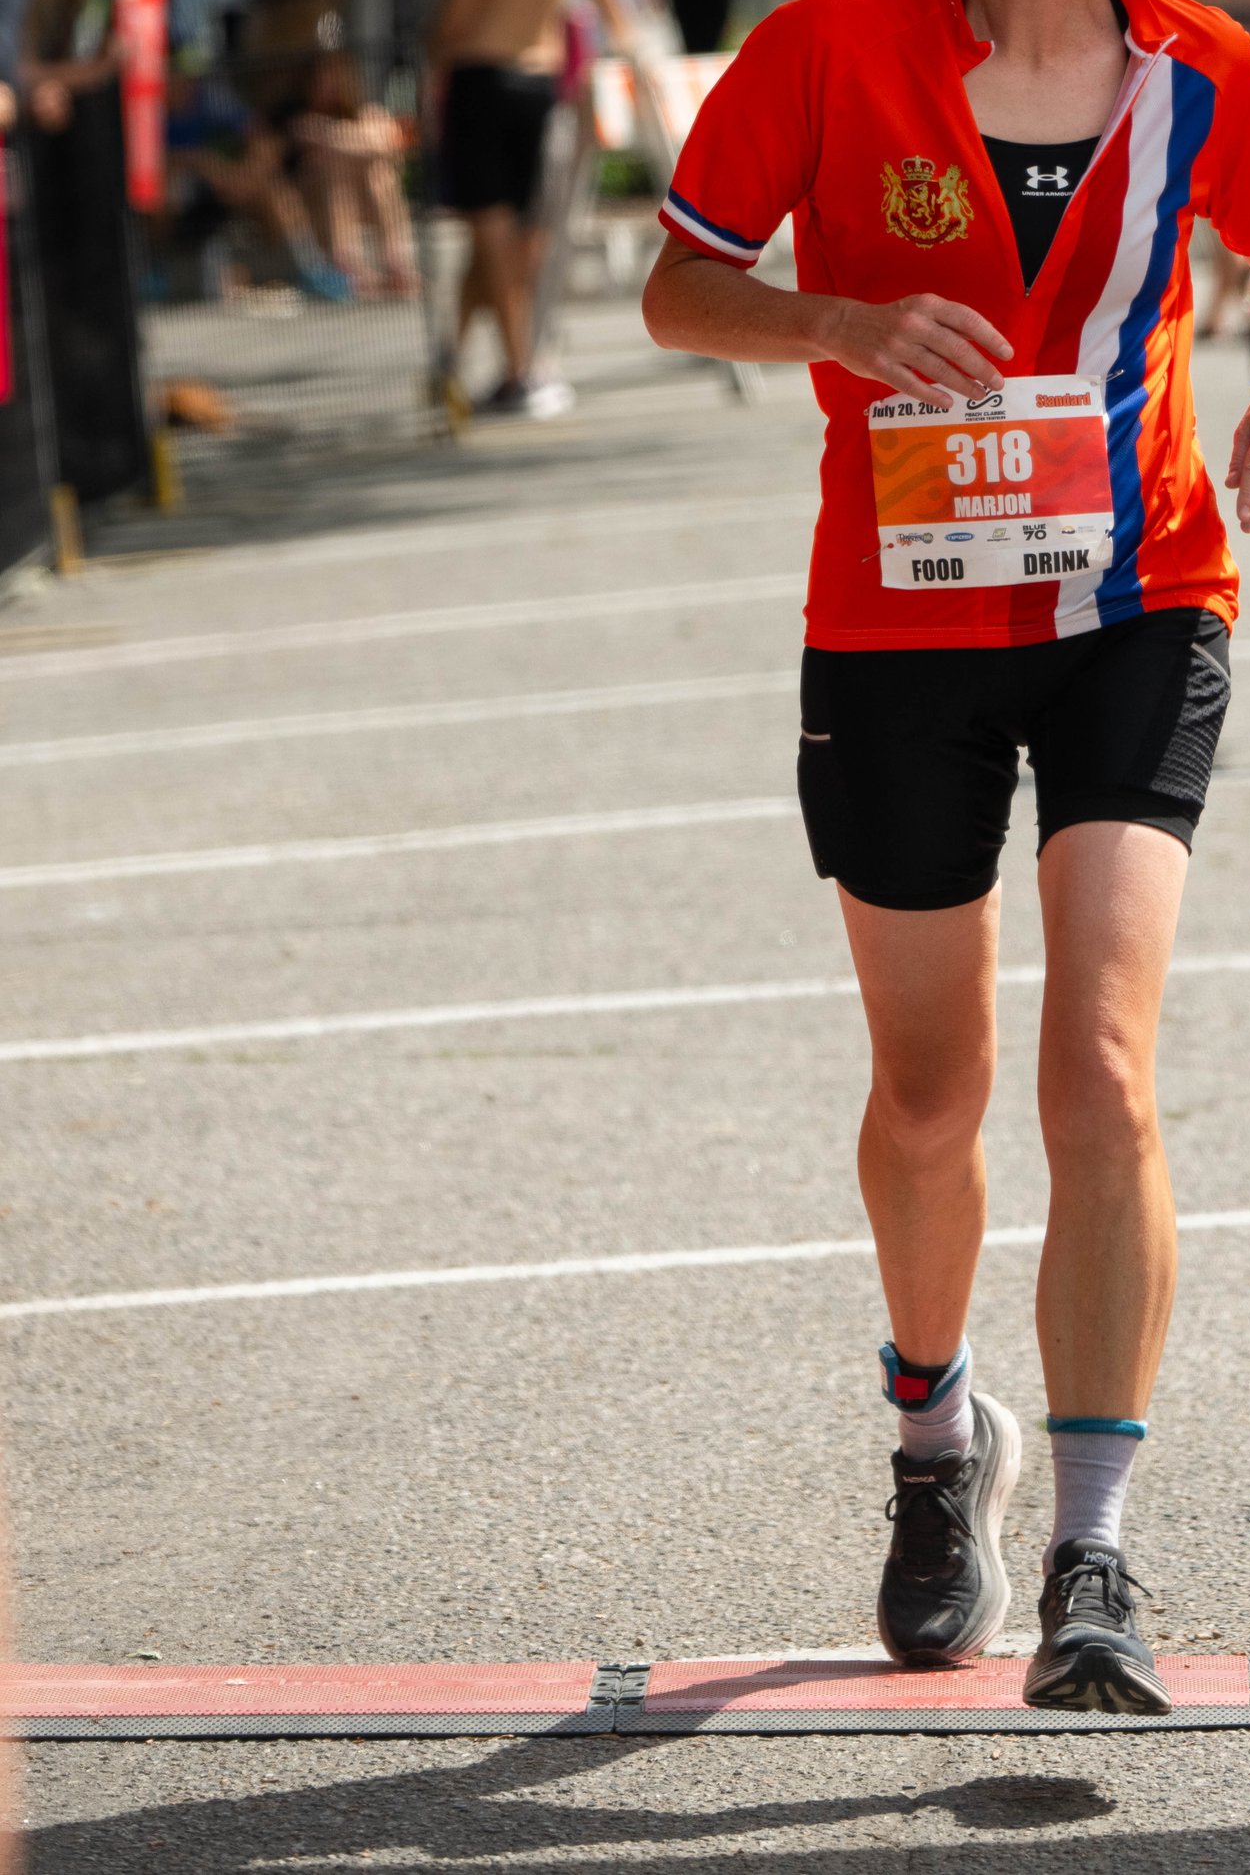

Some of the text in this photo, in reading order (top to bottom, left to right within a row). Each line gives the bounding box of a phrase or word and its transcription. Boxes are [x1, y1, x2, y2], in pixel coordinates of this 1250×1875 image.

[872, 403, 895, 418] July
[898, 402, 916, 417] 20,
[1035, 392, 1091, 408] Standard
[946, 429, 1033, 486] 318
[953, 492, 1032, 518] MARJON
[1023, 530, 1047, 541] 70
[911, 557, 964, 582] FOOD
[1023, 549, 1090, 576] DRINK
[1083, 1550, 1118, 1567] HOKA
